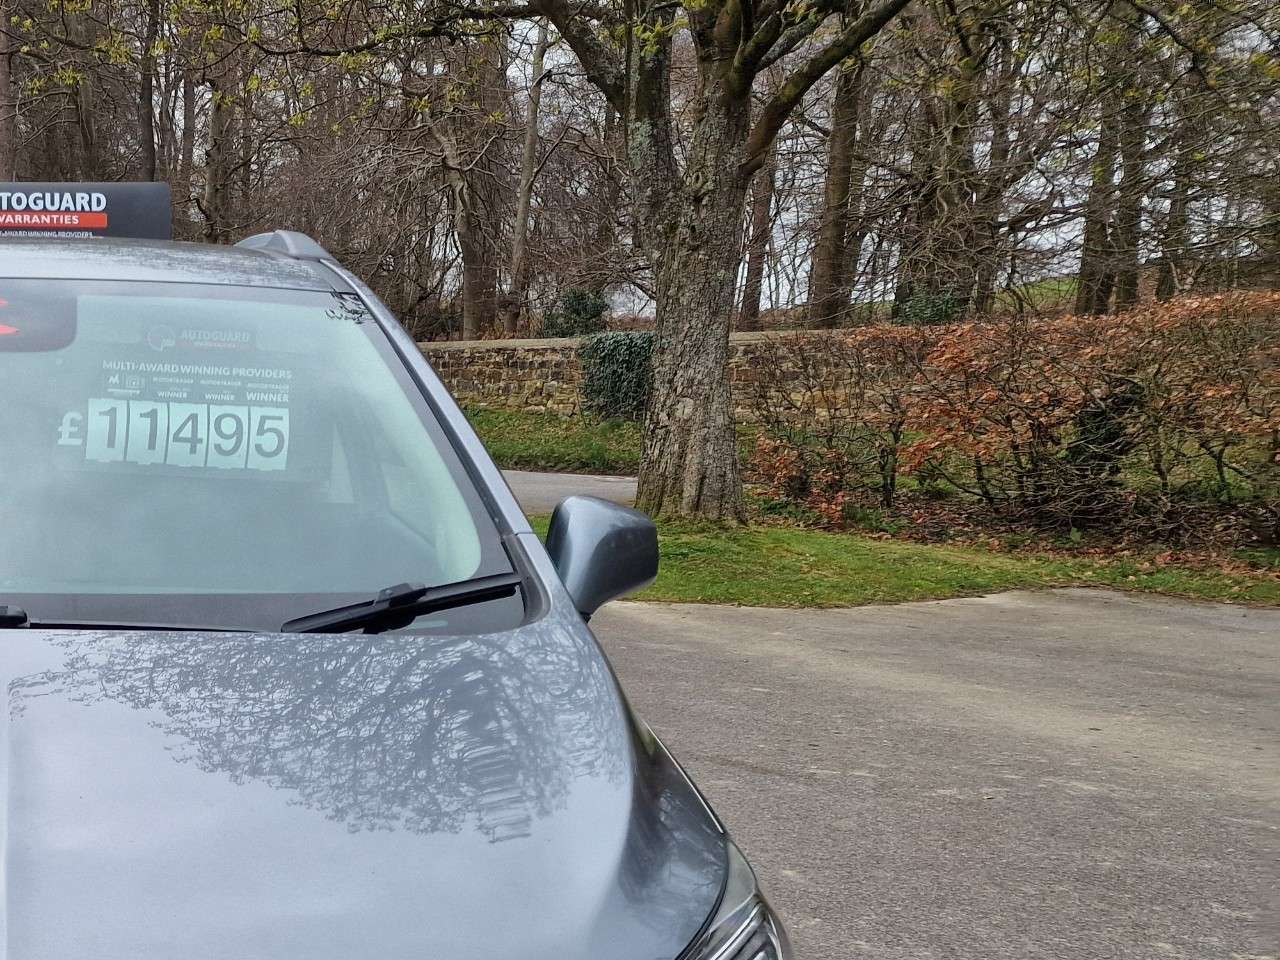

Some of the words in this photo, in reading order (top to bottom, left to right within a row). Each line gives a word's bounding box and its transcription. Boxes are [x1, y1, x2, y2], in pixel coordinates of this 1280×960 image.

[180, 364, 230, 377] WINNING
[232, 367, 293, 380] PROVIDERS
[246, 391, 289, 403] WINNER
